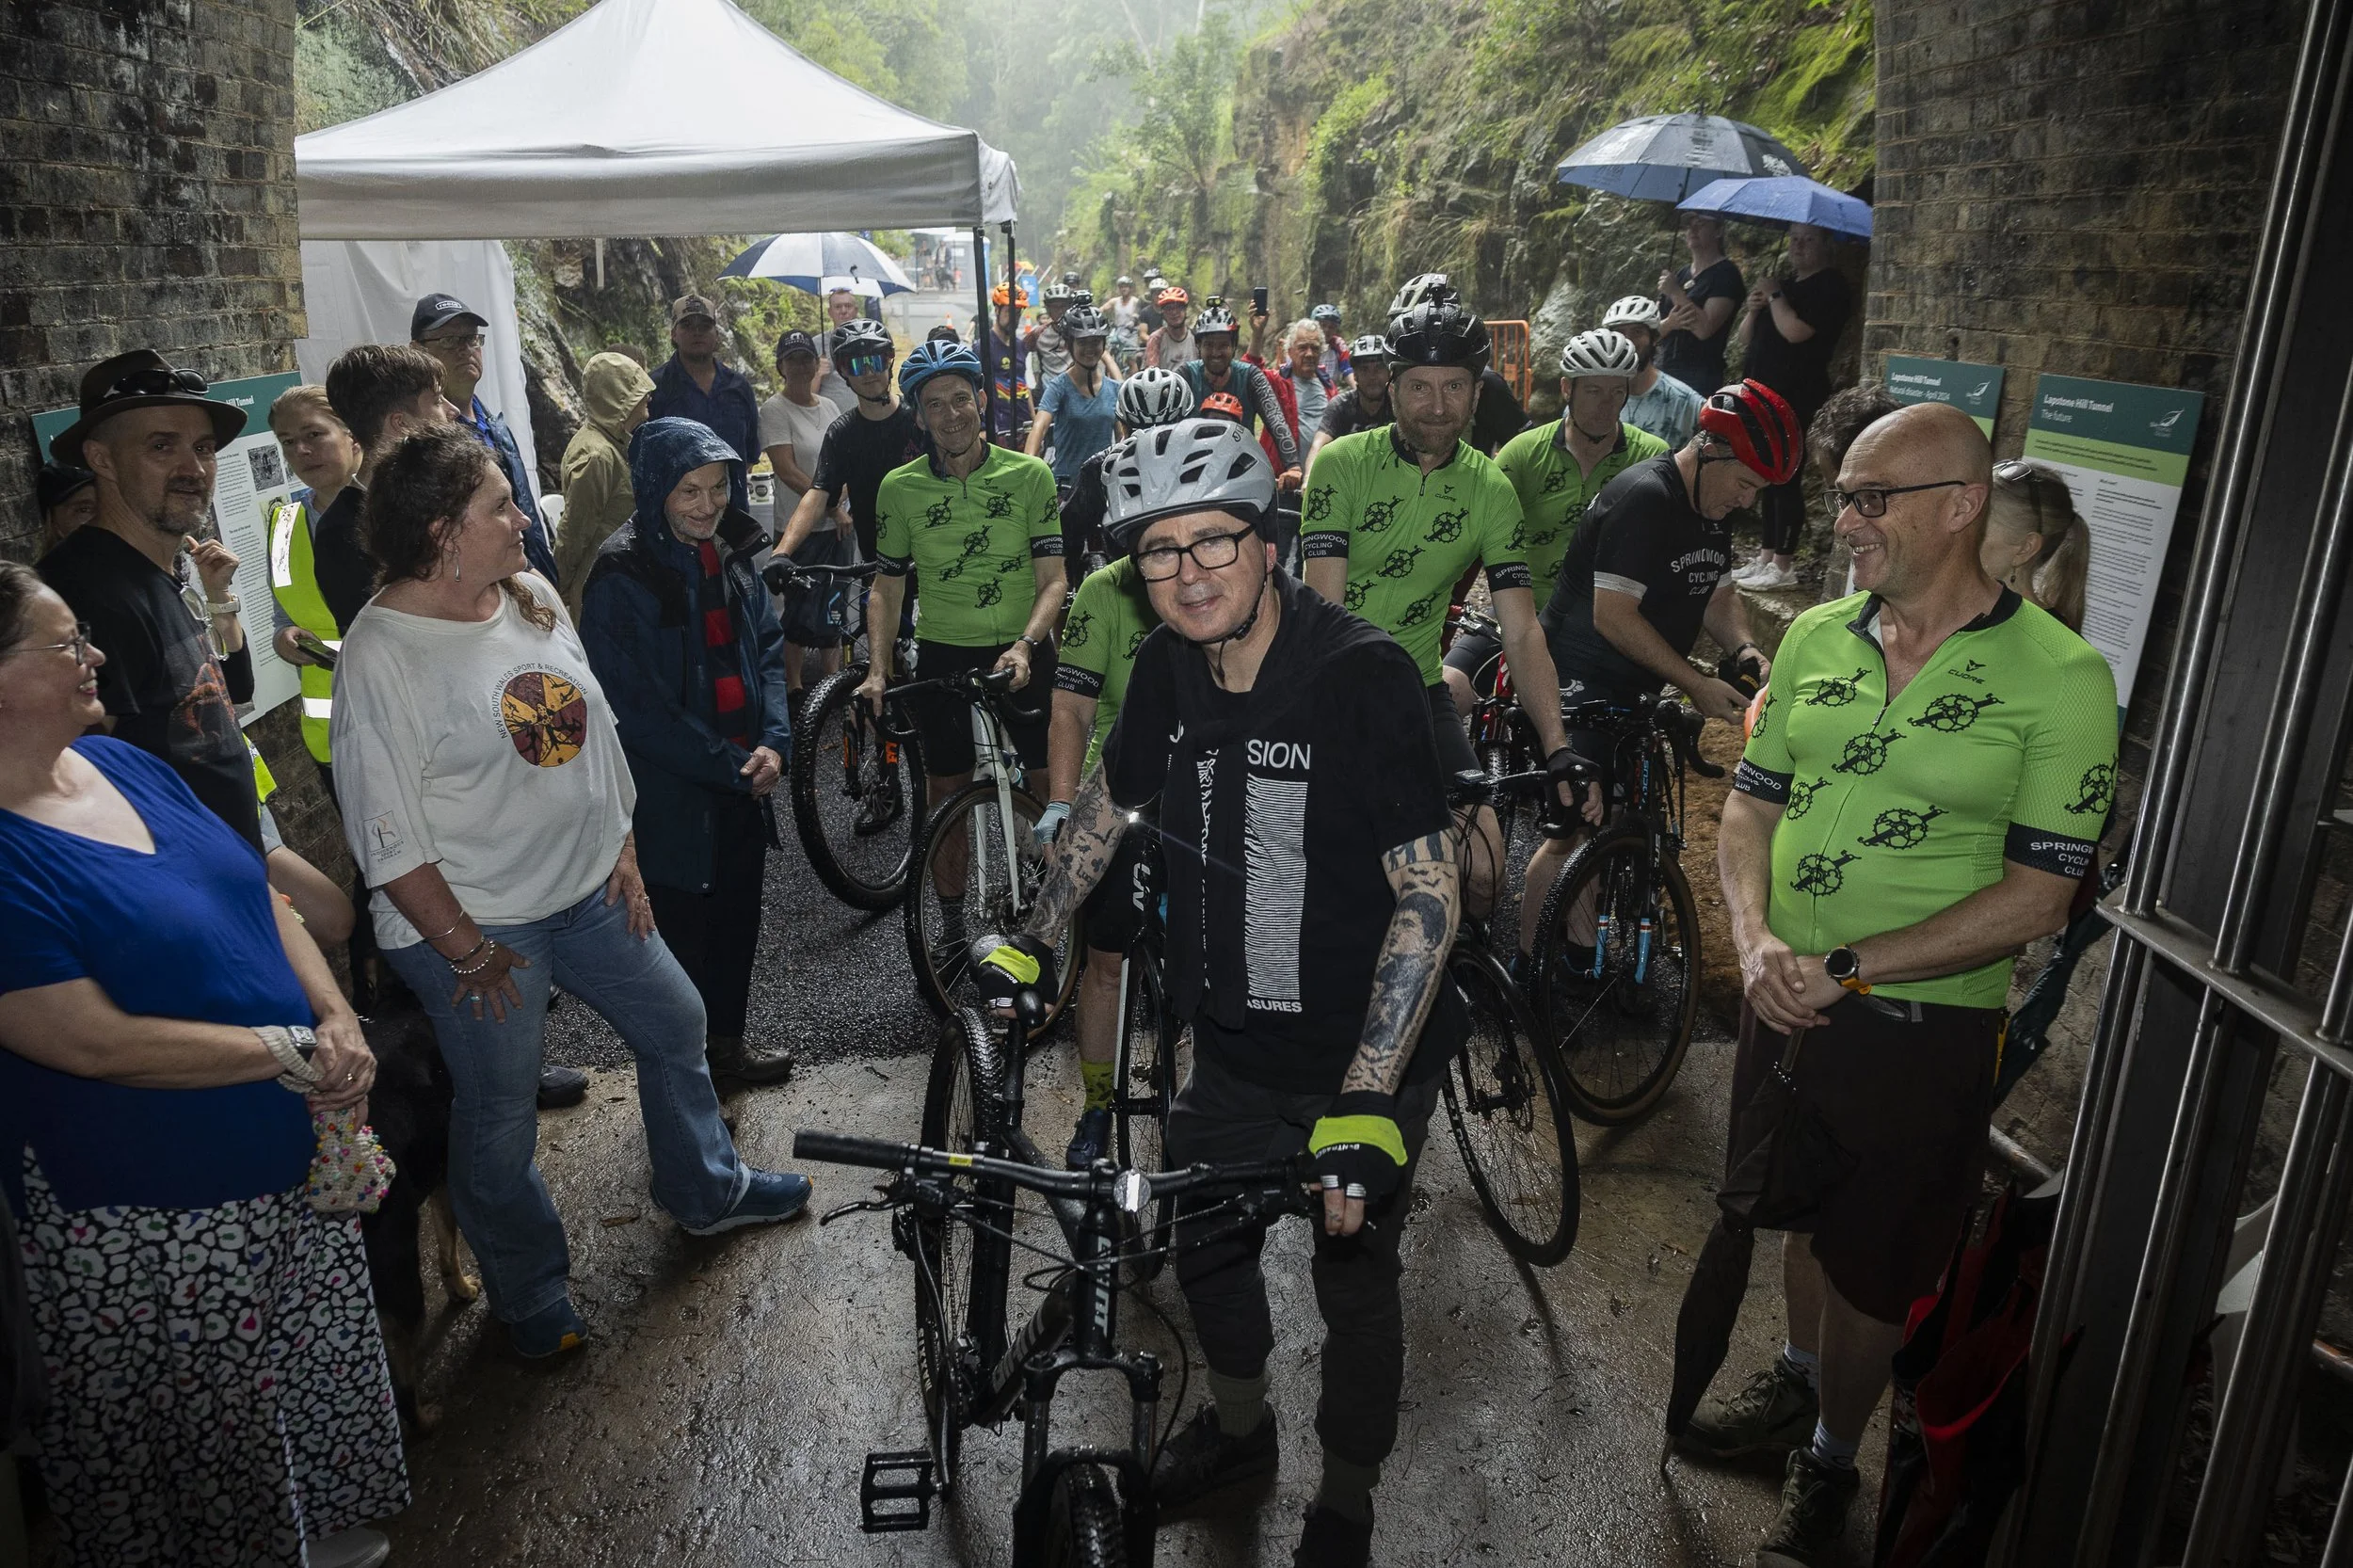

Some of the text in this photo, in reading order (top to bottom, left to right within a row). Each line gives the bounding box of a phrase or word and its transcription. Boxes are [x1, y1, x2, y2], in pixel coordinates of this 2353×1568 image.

[2043, 393, 2115, 413] Lapstone Hill Tunnel
[2041, 408, 2073, 424] The future
[512, 663, 536, 674] SPORT
[495, 670, 514, 692] WALES
[545, 664, 588, 695] RECREATION
[491, 695, 502, 718] SOUTH
[495, 719, 508, 740] NEW
[1246, 739, 1311, 770] SION
[1246, 1000, 1303, 1014] ASURES
